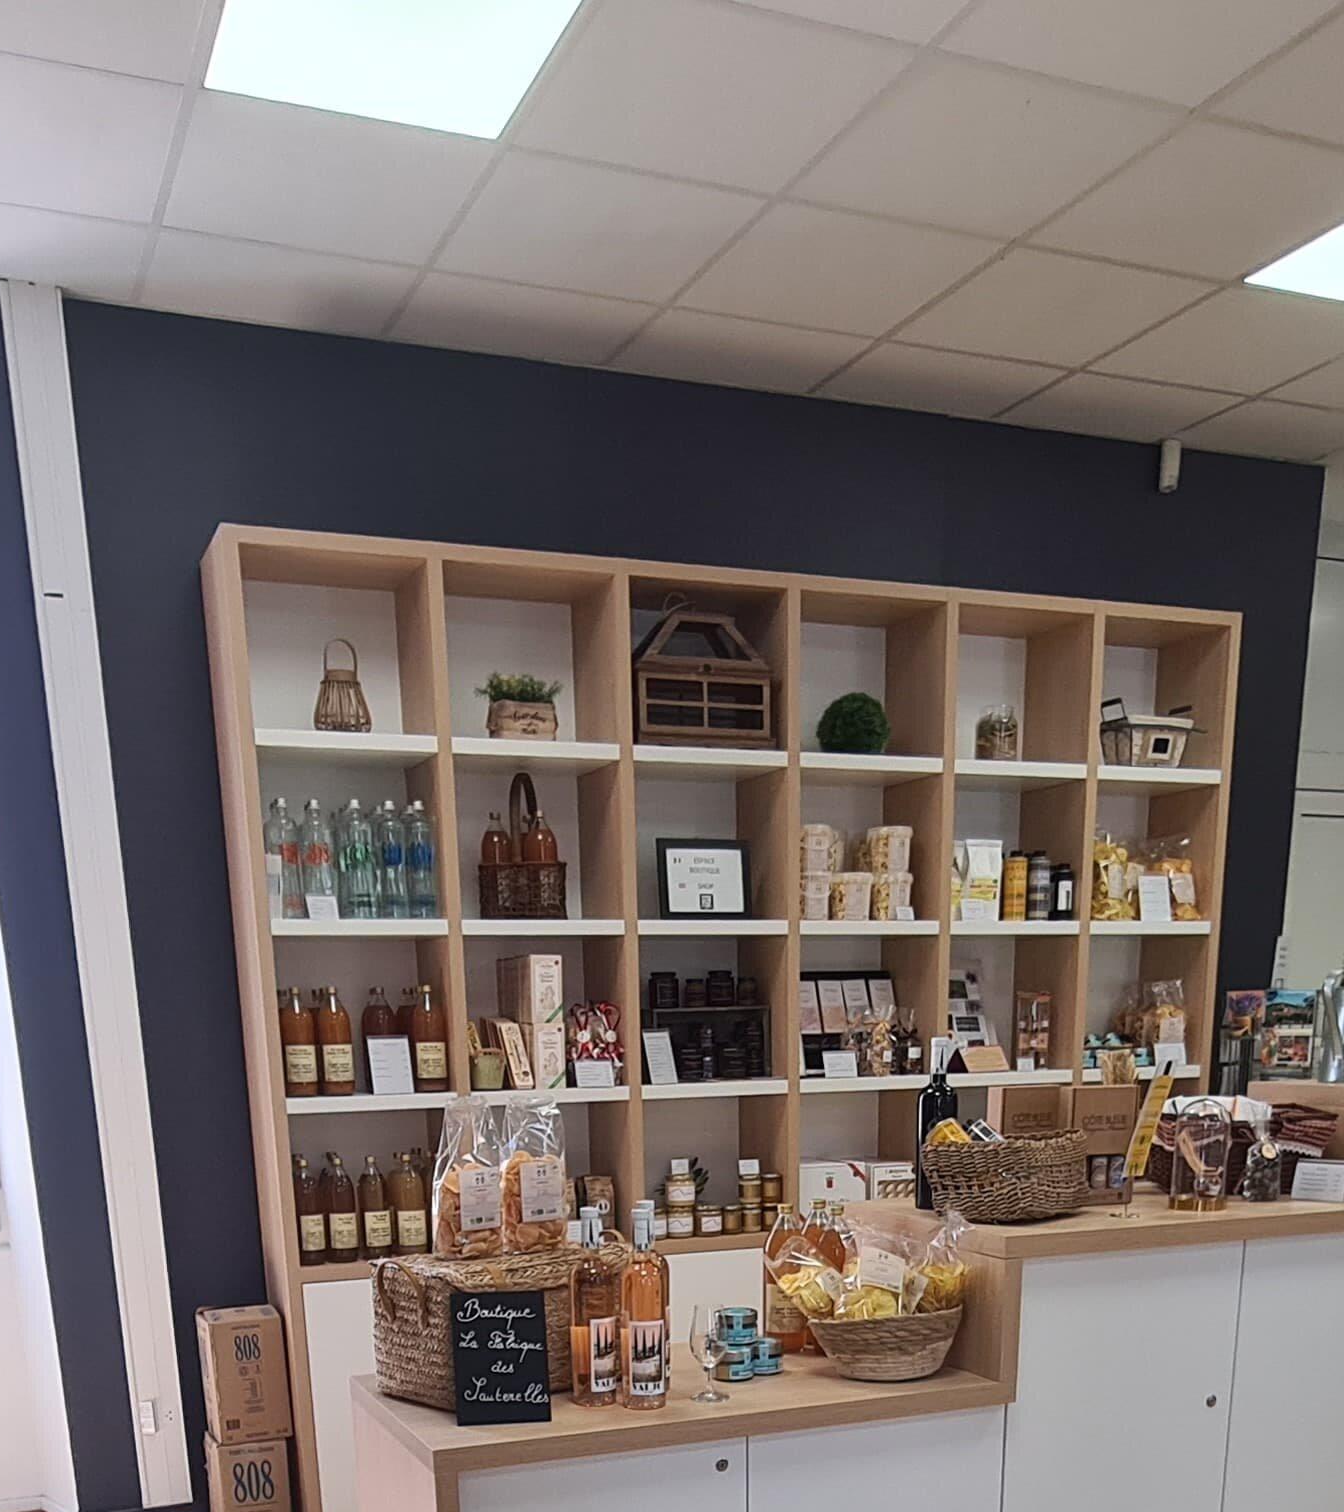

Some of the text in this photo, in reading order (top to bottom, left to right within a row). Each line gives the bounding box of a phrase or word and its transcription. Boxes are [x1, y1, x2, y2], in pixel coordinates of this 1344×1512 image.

[457, 1298, 537, 1331] Boutique
[234, 1333, 262, 1362] 808
[459, 1330, 479, 1350] La
[490, 1360, 515, 1374] des
[463, 1376, 550, 1404] Sauterelles
[232, 1459, 276, 1504] 808
